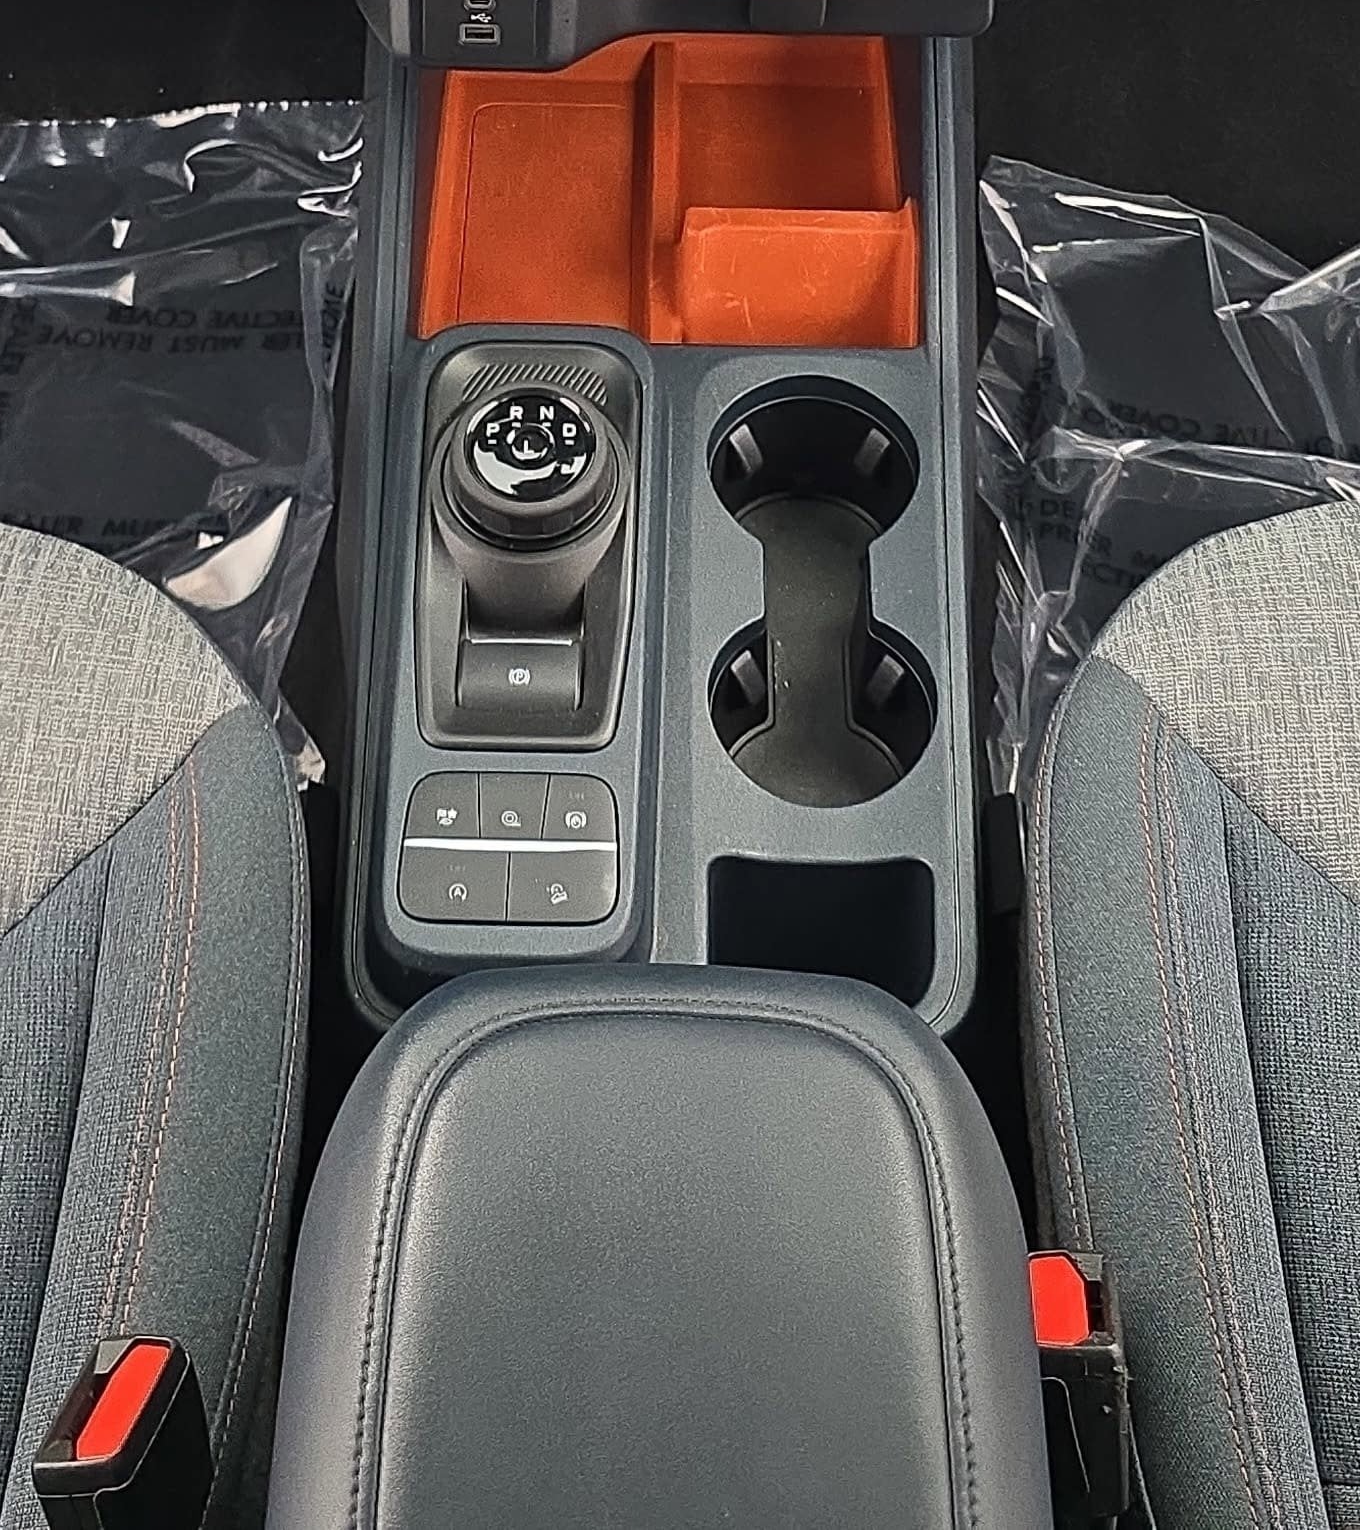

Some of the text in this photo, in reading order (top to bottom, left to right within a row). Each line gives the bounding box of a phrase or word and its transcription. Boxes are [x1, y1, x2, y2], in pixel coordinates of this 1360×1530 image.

[106, 303, 197, 328] COVER
[36, 324, 153, 353] REMOVE
[167, 332, 246, 354] MUST
[510, 406, 554, 420] R N
[486, 423, 500, 437] P
[562, 423, 577, 437] D
[523, 440, 535, 453] L
